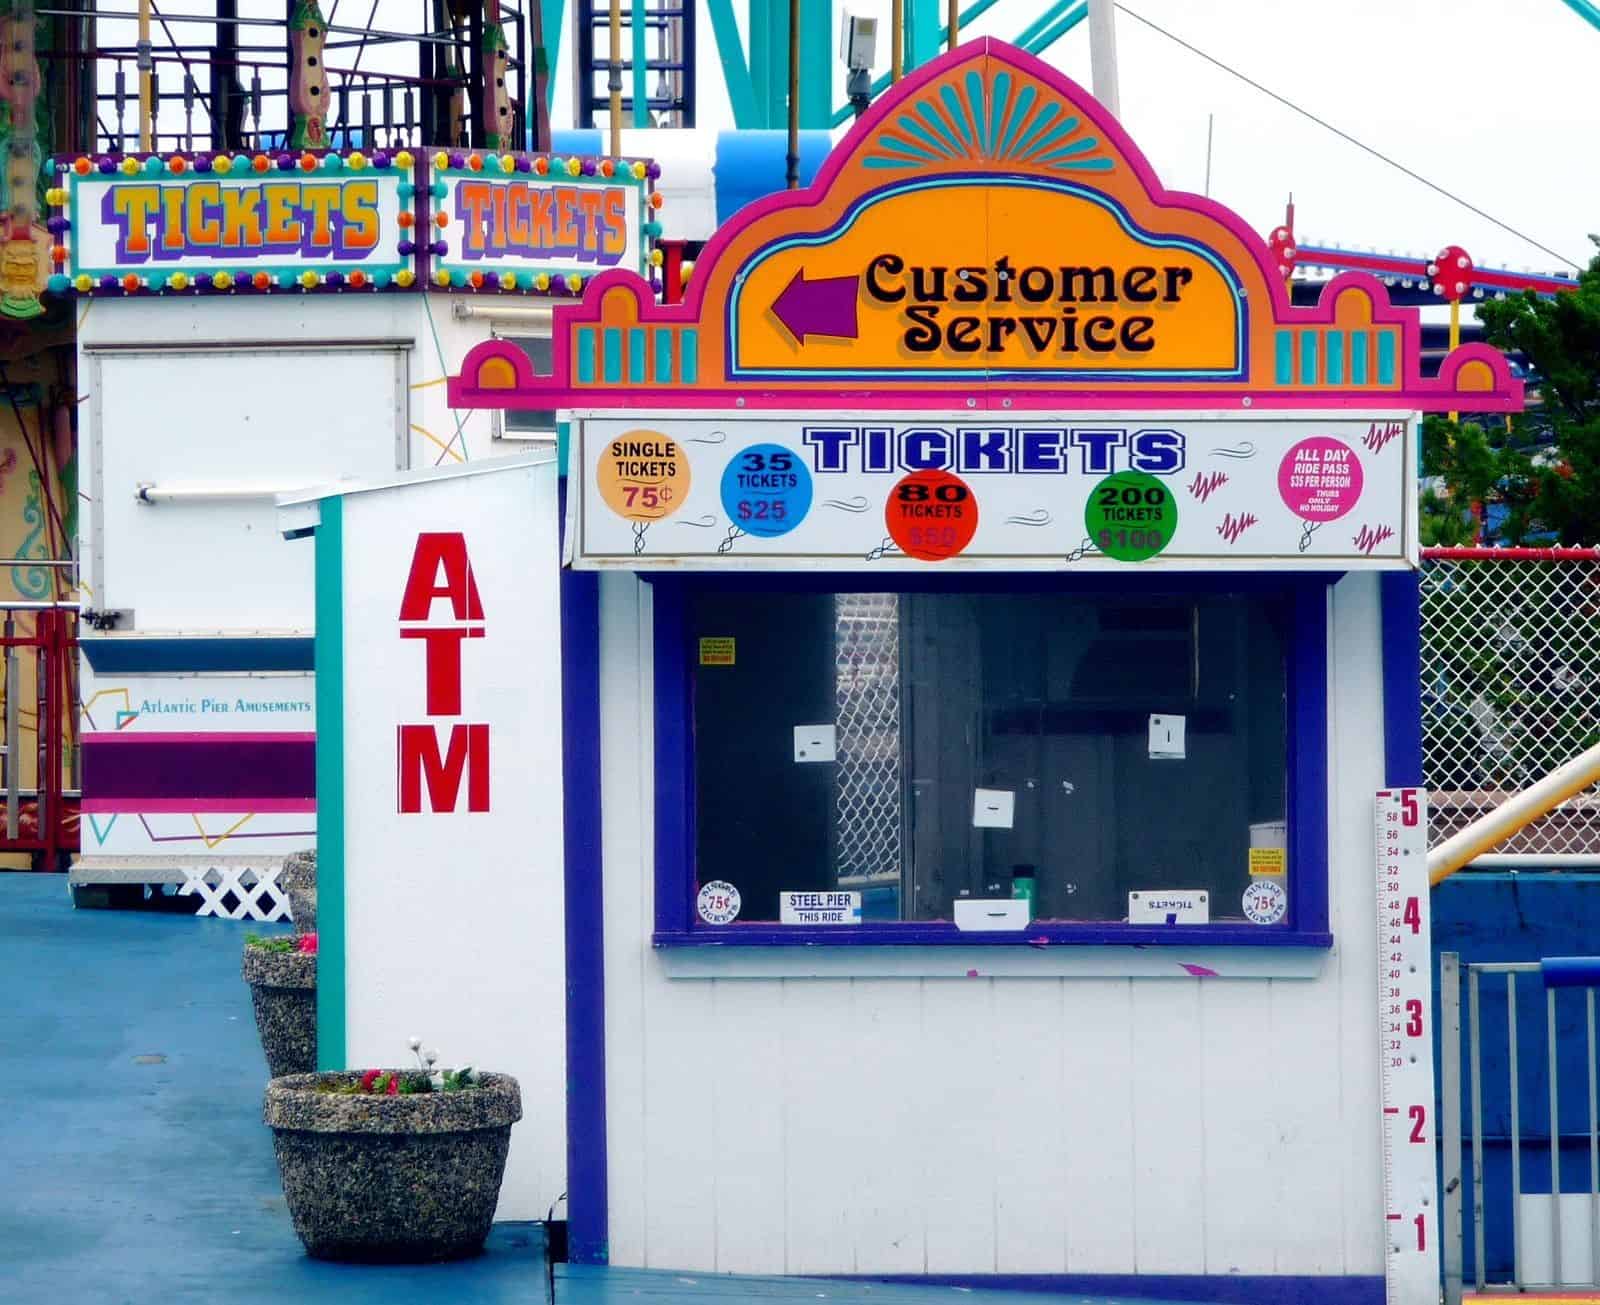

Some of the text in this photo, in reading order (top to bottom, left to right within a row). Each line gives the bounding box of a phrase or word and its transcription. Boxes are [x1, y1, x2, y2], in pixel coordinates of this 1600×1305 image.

[102, 180, 381, 264] TICKETS
[455, 180, 627, 265] TICKETS
[866, 254, 1193, 303] Customer
[903, 305, 1156, 353] Service
[612, 441, 676, 458] SINGLE
[802, 426, 1187, 476] TICKETS
[1295, 449, 1350, 462] ALL DAY
[616, 461, 677, 478] TICKETS
[741, 453, 795, 472] 35
[1294, 463, 1350, 474] RIDE PASS
[737, 473, 798, 489] TICKETS
[1290, 476, 1351, 488] $35 PER PERSON
[622, 486, 673, 509] 75¢
[898, 484, 967, 502] 80
[1099, 487, 1165, 506] 200
[737, 500, 787, 521] $25
[901, 504, 963, 518] TICKETS
[1103, 507, 1162, 521] TICKETS
[910, 527, 957, 546] $50
[1099, 529, 1162, 549] $100
[397, 532, 490, 814] ATM
[1400, 788, 1419, 827] 5
[1386, 811, 1399, 822] 58
[1386, 829, 1399, 840] 56
[1387, 847, 1399, 857] 54
[1387, 865, 1399, 876] 52
[1387, 882, 1399, 892] 50
[709, 895, 730, 911] 75¢
[790, 893, 852, 907] STEEL PIER
[1253, 896, 1276, 910] 75¢
[1388, 900, 1400, 910] 48
[798, 911, 844, 922] THIS RIDE
[1389, 917, 1401, 928] 46
[1403, 896, 1421, 935] 4
[1389, 935, 1401, 945] 44
[1390, 952, 1402, 963] 42
[1389, 969, 1401, 979] 40
[1389, 987, 1401, 998] 38
[1389, 1004, 1401, 1015] 36
[1406, 998, 1423, 1038] 3
[1389, 1022, 1401, 1033] 34
[1389, 1040, 1401, 1050] 32
[1391, 1057, 1402, 1067] 30
[1409, 1104, 1426, 1144] 2
[1413, 1213, 1426, 1252] 1
